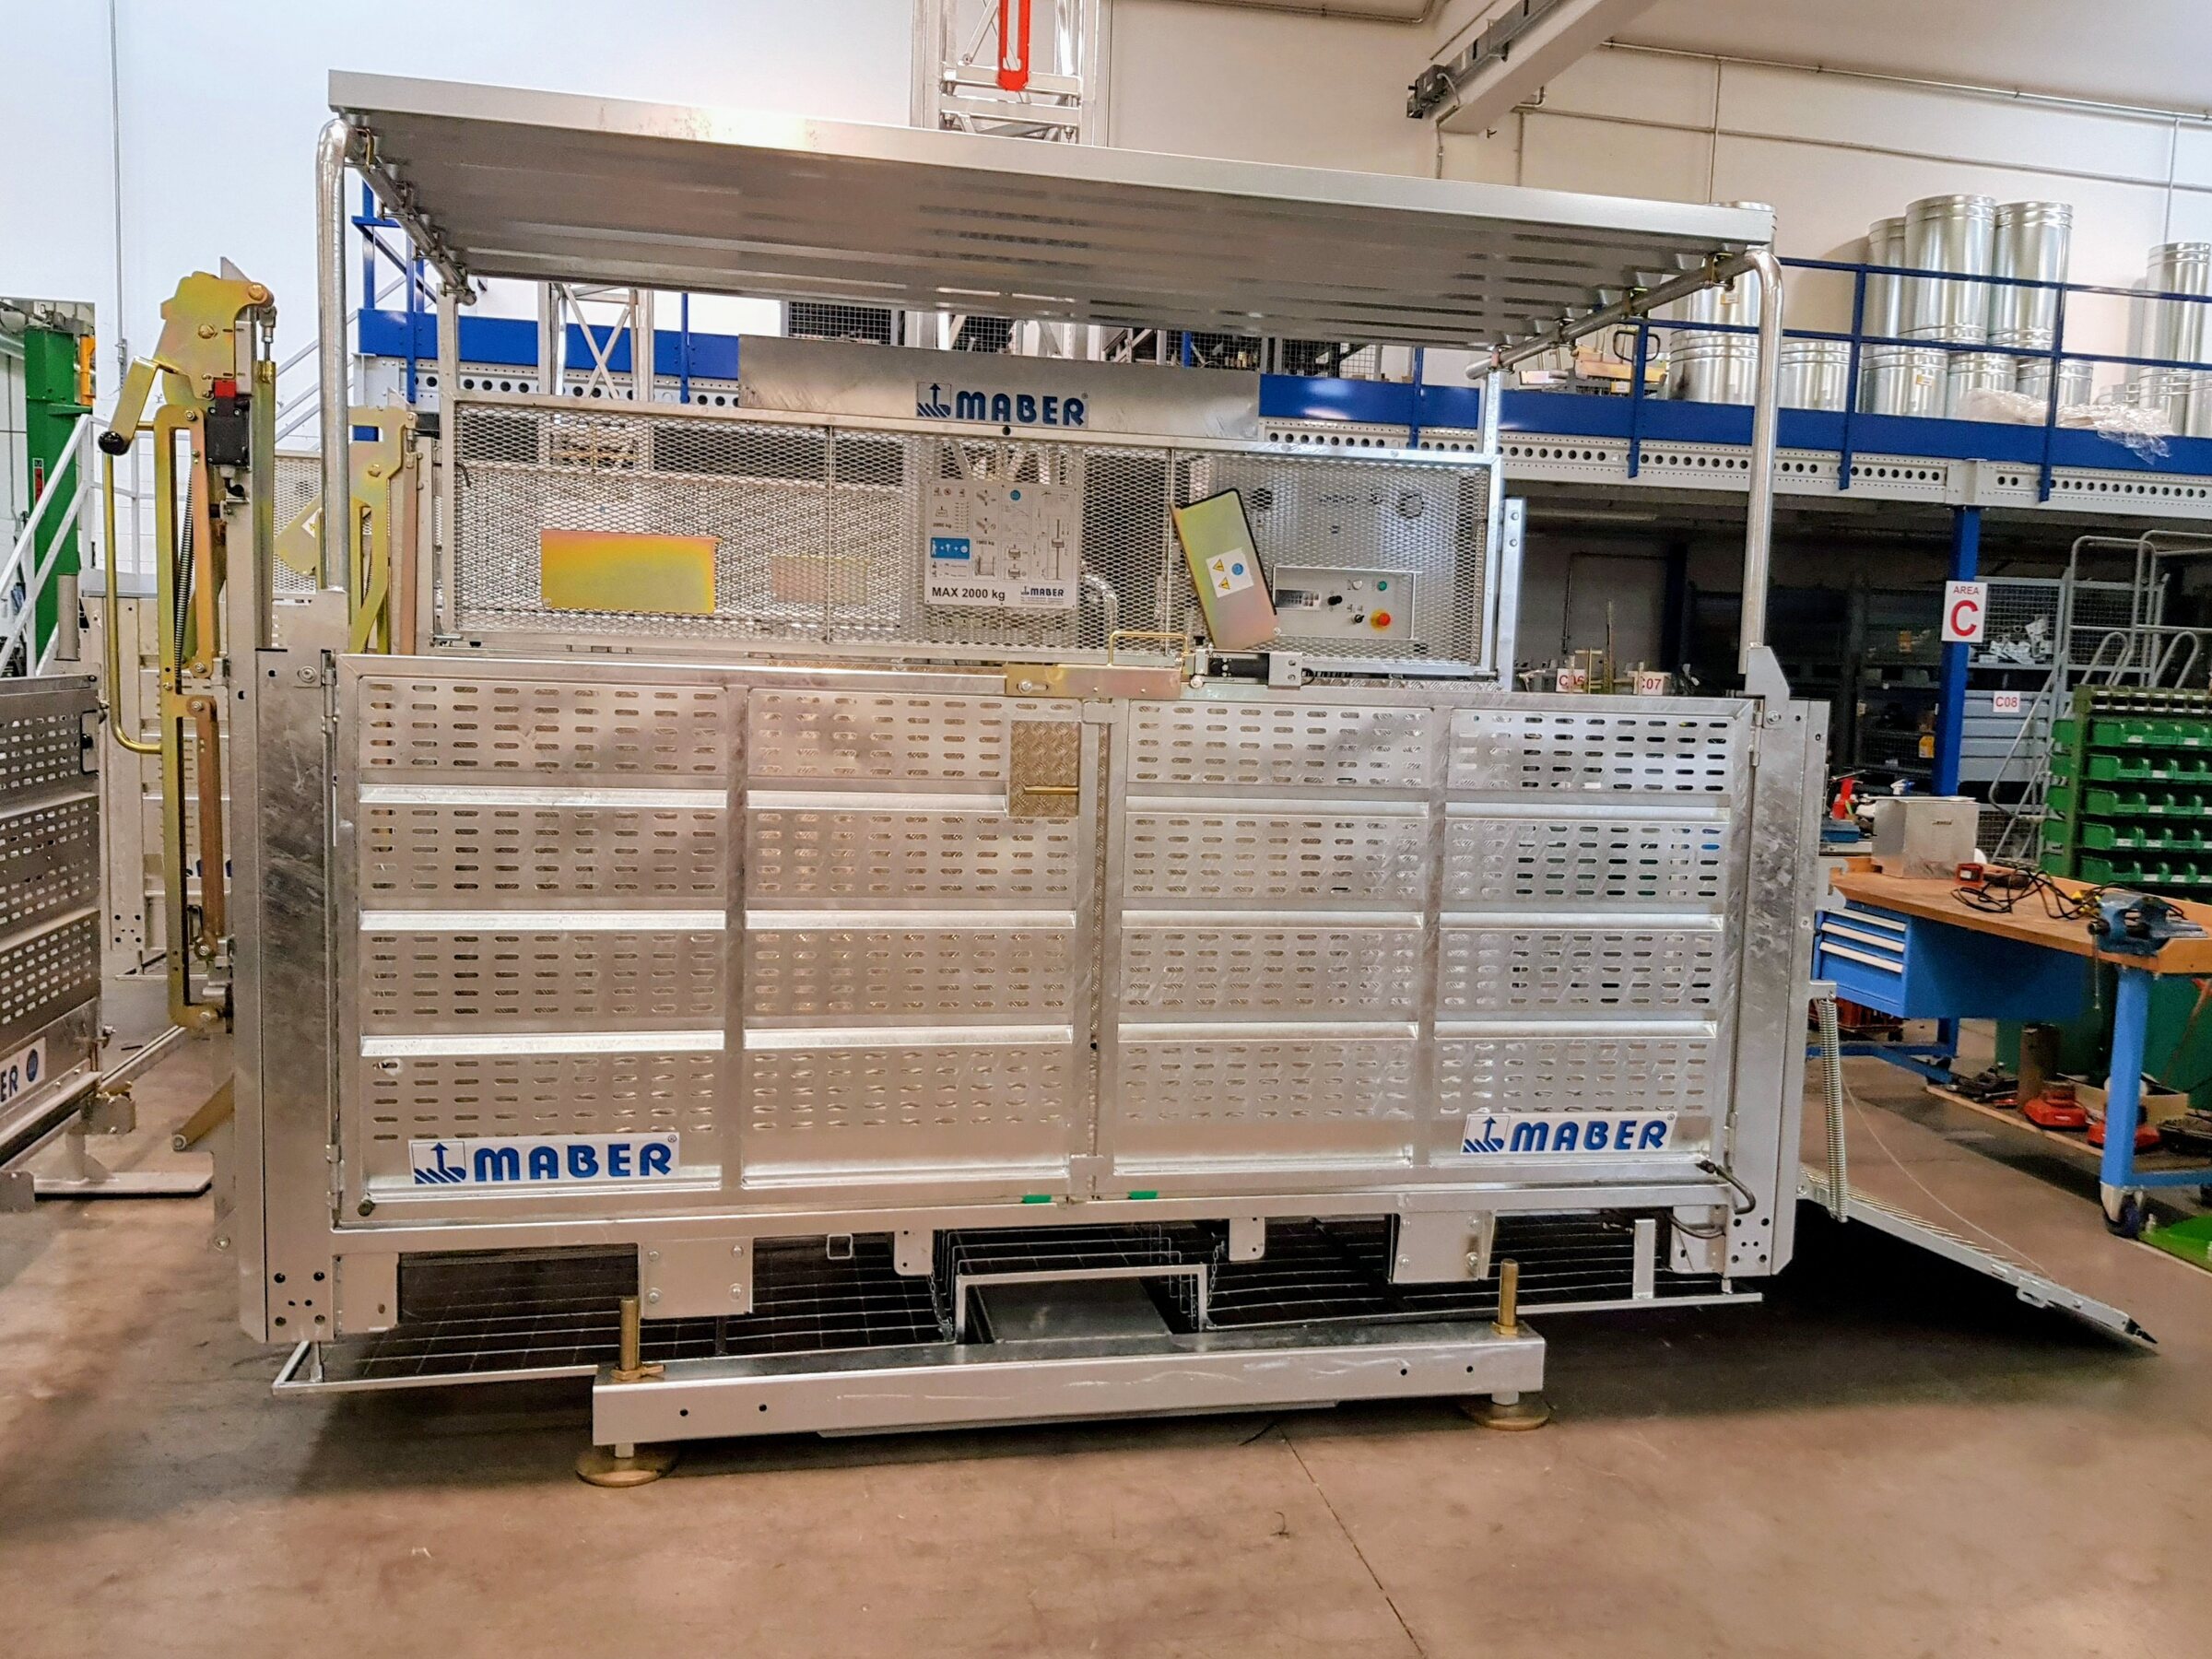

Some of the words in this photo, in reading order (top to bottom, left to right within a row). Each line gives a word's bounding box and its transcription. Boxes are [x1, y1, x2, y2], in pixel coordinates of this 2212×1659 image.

[956, 390, 1085, 427] MABER
[932, 586, 959, 597] MAX
[961, 588, 989, 599] 2000
[992, 589, 1006, 602] kg
[1030, 587, 1065, 597] MABER
[1953, 585, 1980, 595] AREA
[1950, 599, 1979, 637] C
[1995, 696, 2018, 708] C08
[1509, 1119, 1667, 1152] MABER
[473, 1142, 673, 1182] MABER
